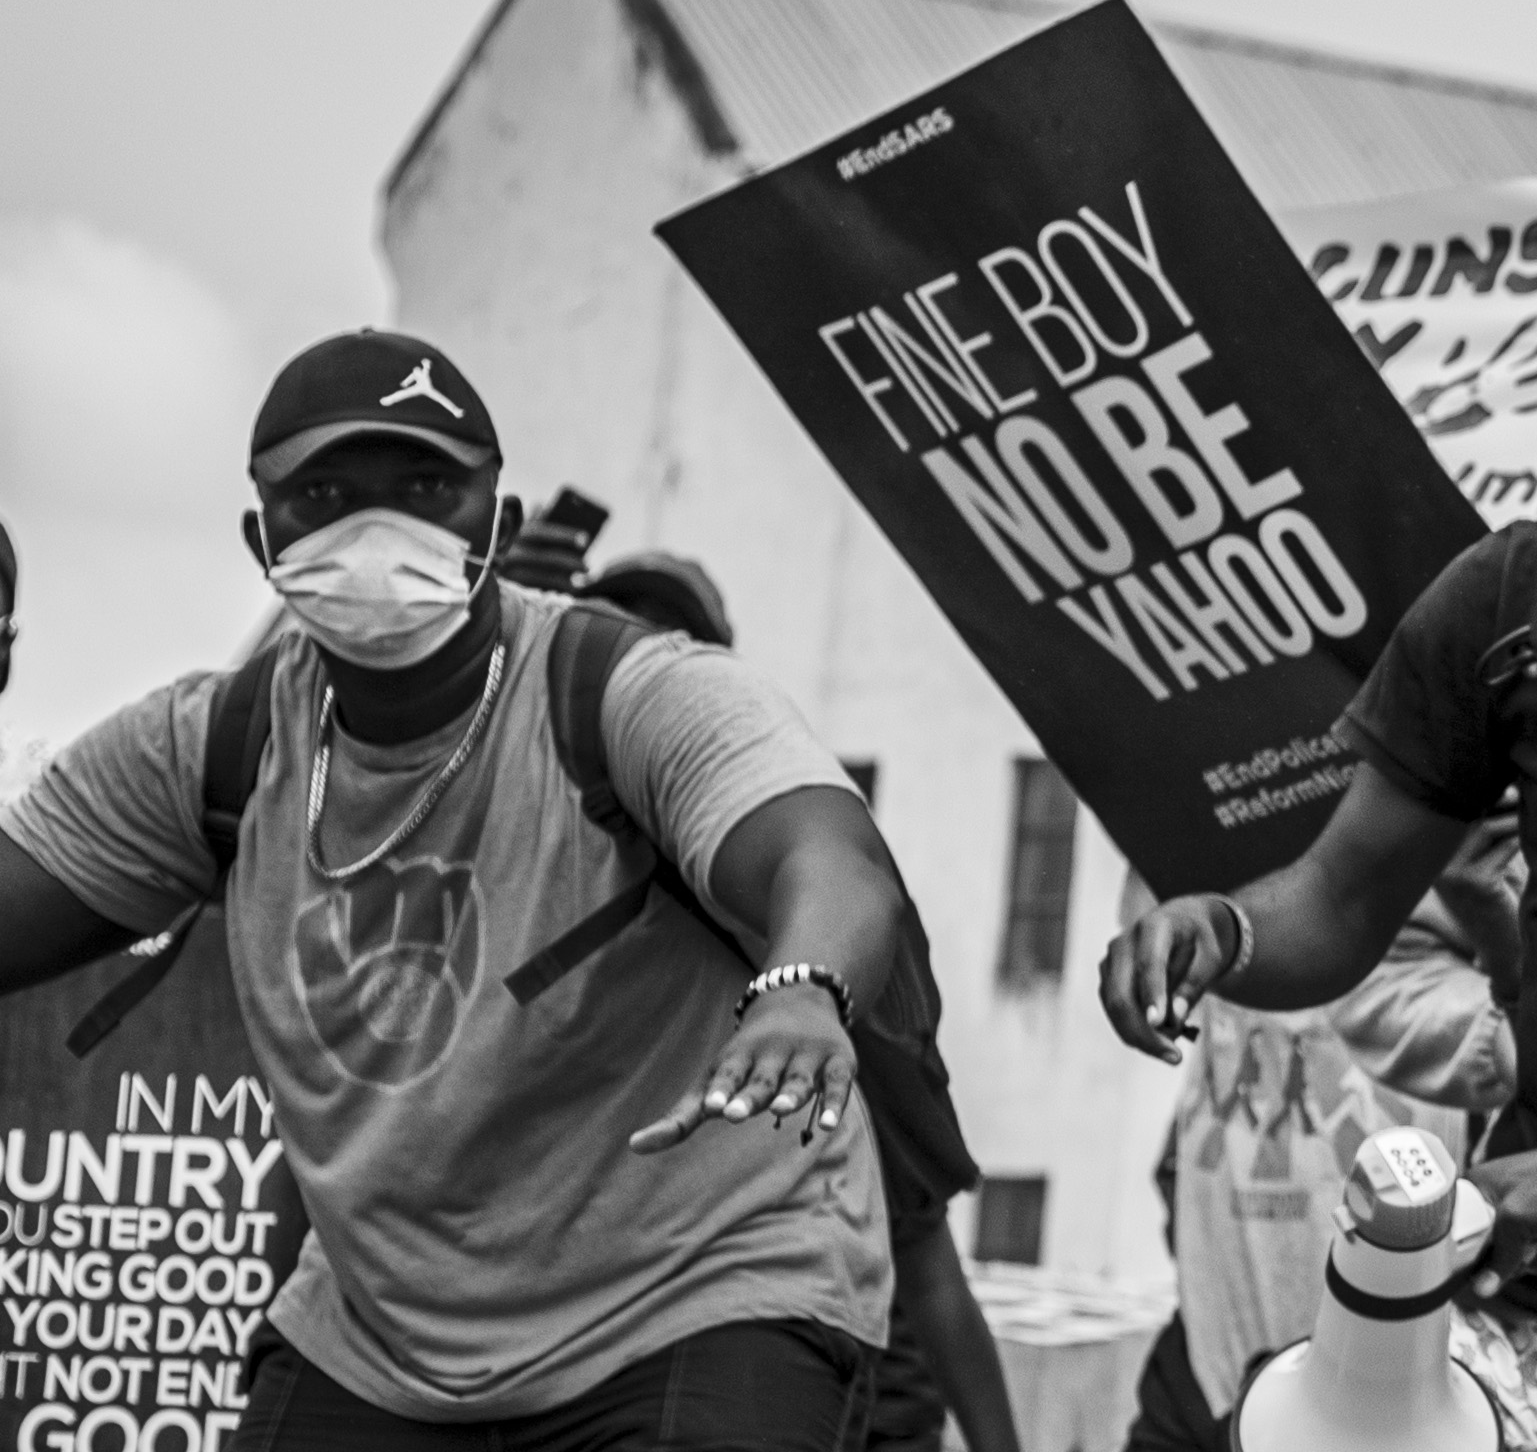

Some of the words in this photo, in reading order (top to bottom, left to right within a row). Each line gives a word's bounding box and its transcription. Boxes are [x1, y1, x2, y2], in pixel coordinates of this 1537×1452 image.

[836, 104, 955, 182] #EndSARS
[819, 270, 1039, 453] FINE
[978, 179, 1194, 388] BOY
[920, 414, 1134, 604] NO
[1069, 331, 1303, 550] BE
[1056, 507, 1368, 701] YAHOO
[116, 1071, 177, 1133] IN
[191, 1074, 275, 1139] MY
[0, 1128, 284, 1210] UNTRY
[51, 1203, 172, 1250] STEP
[174, 1208, 278, 1256] OUT
[118, 1252, 274, 1307] GOOD
[4, 1298, 152, 1352] YOUR
[156, 1305, 264, 1358] DAY
[43, 1353, 154, 1405] NOT
